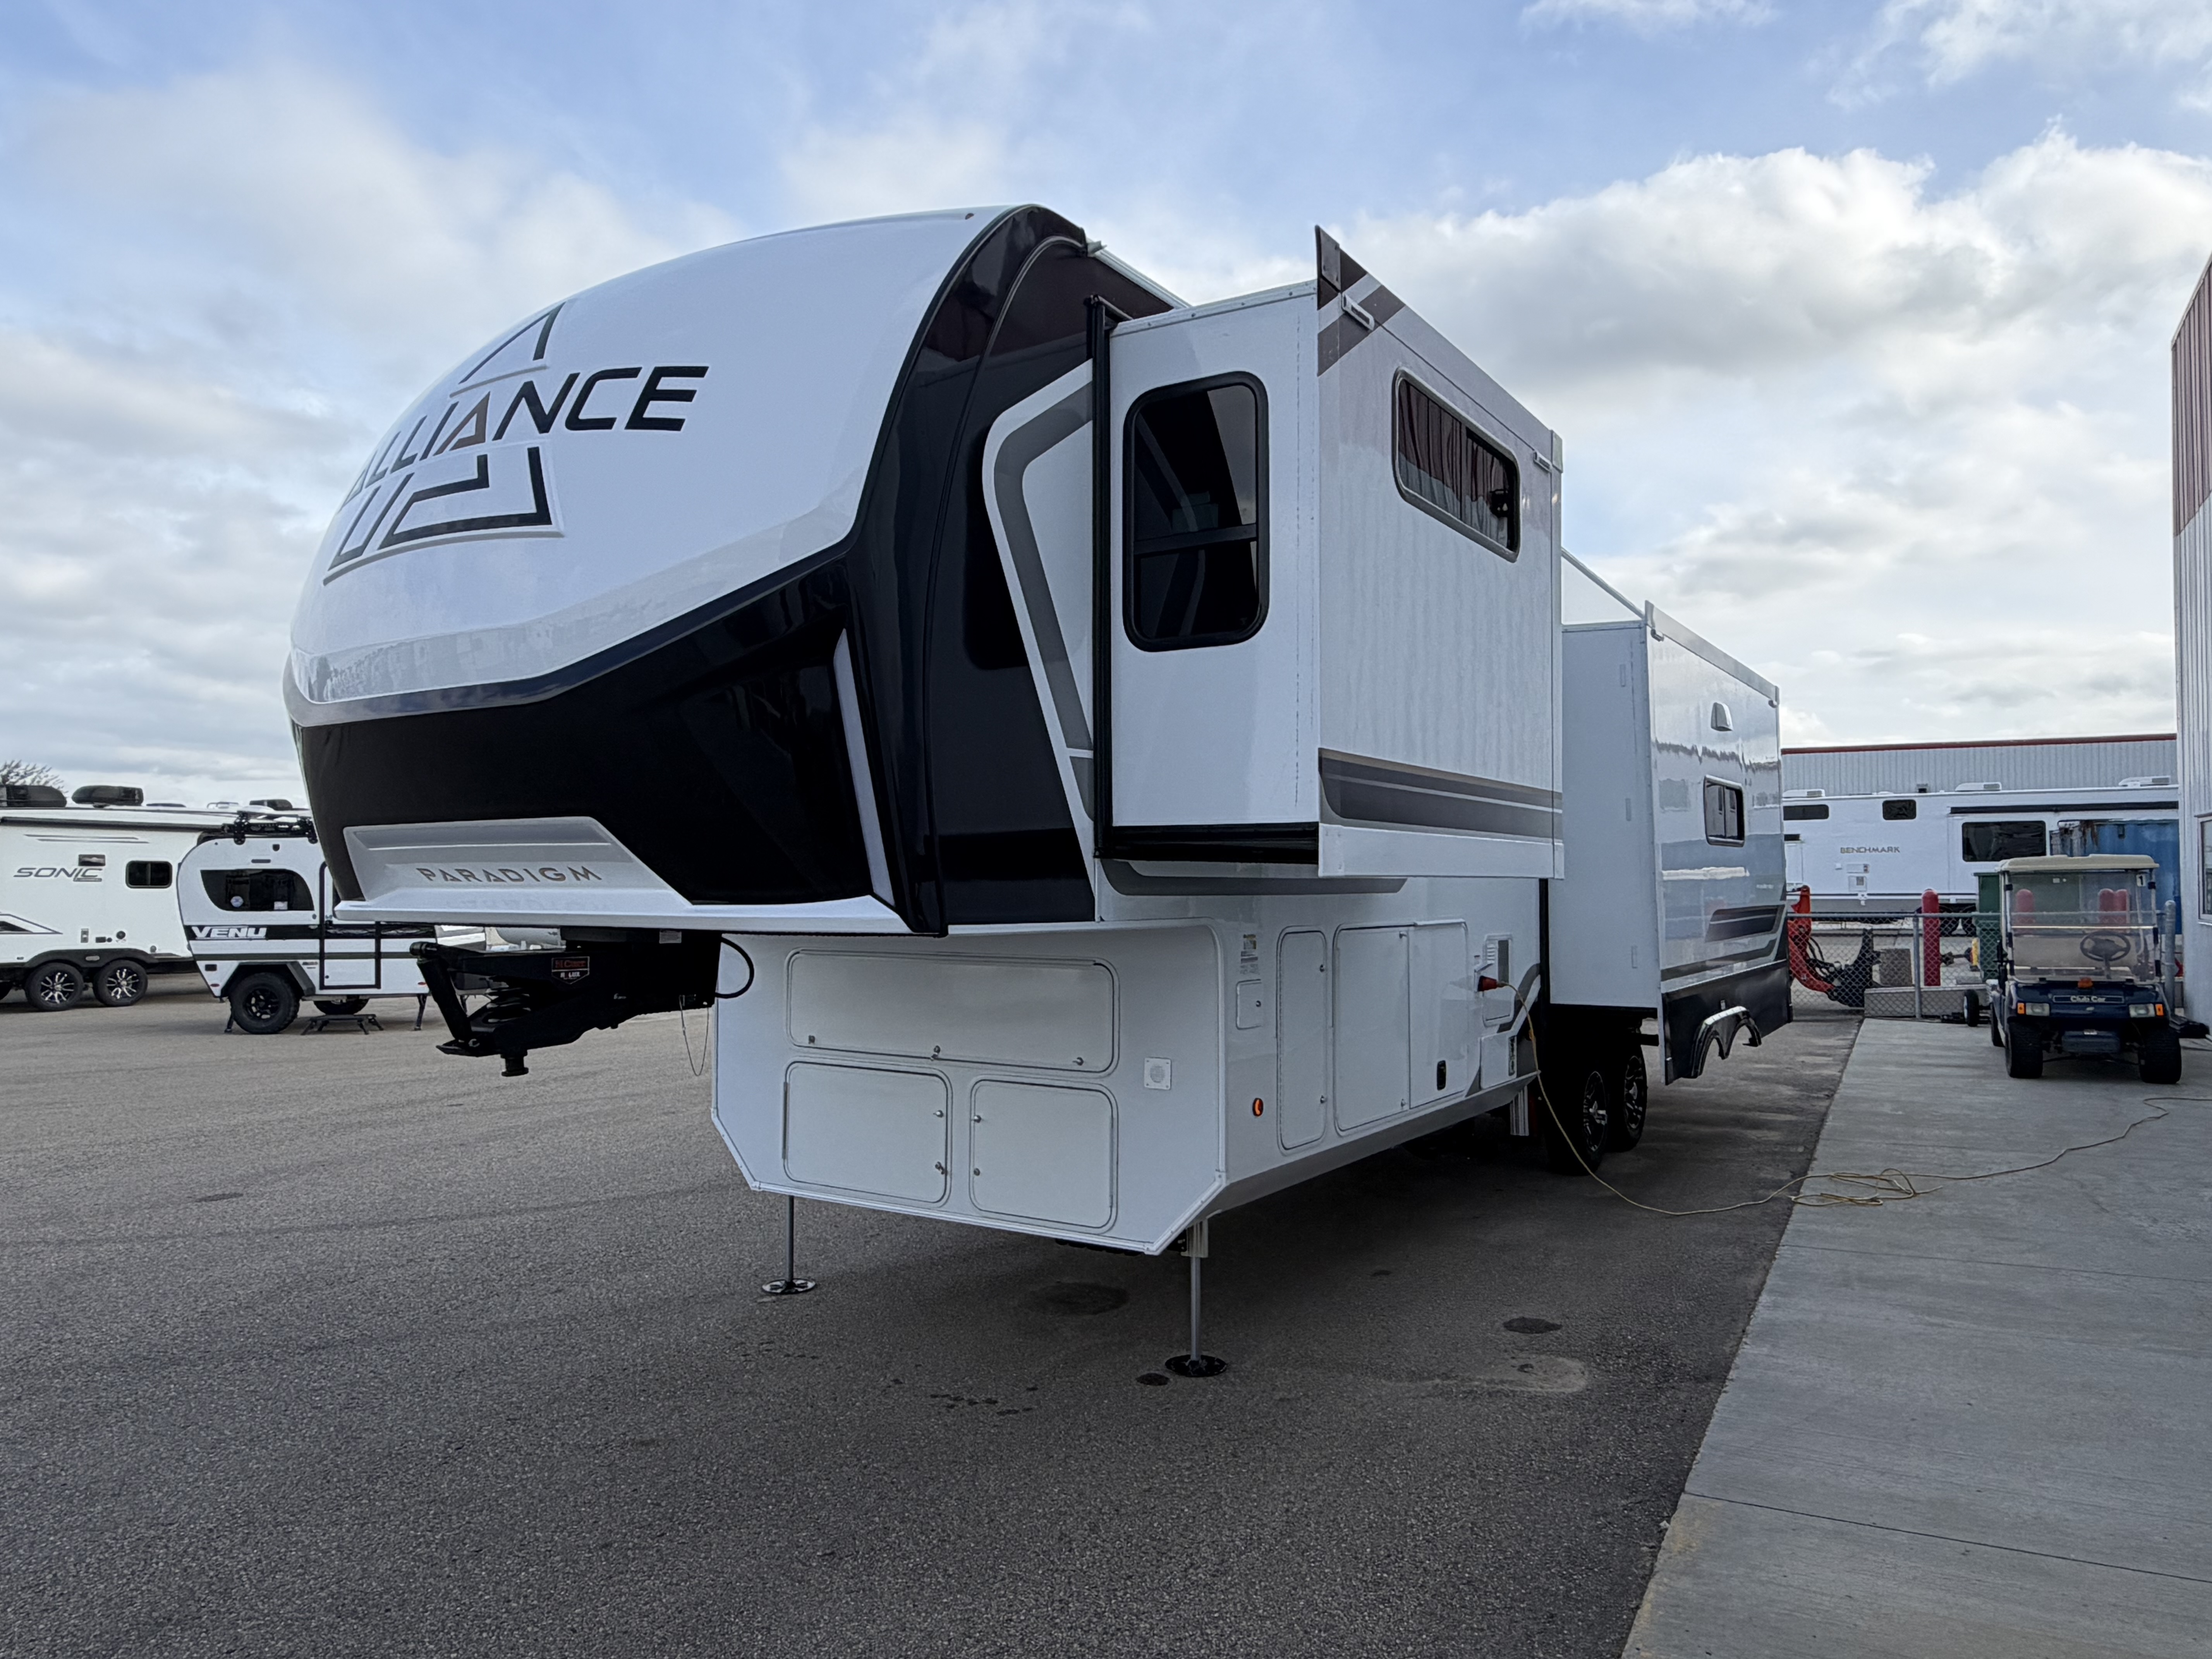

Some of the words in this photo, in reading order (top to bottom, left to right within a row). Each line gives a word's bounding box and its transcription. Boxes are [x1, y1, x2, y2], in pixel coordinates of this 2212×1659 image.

[337, 366, 709, 514] ALLIANCE
[13, 867, 103, 882] SONIC
[416, 866, 603, 882] PARADIGM
[2138, 875, 2143, 885] 1
[191, 926, 268, 939] VENU
